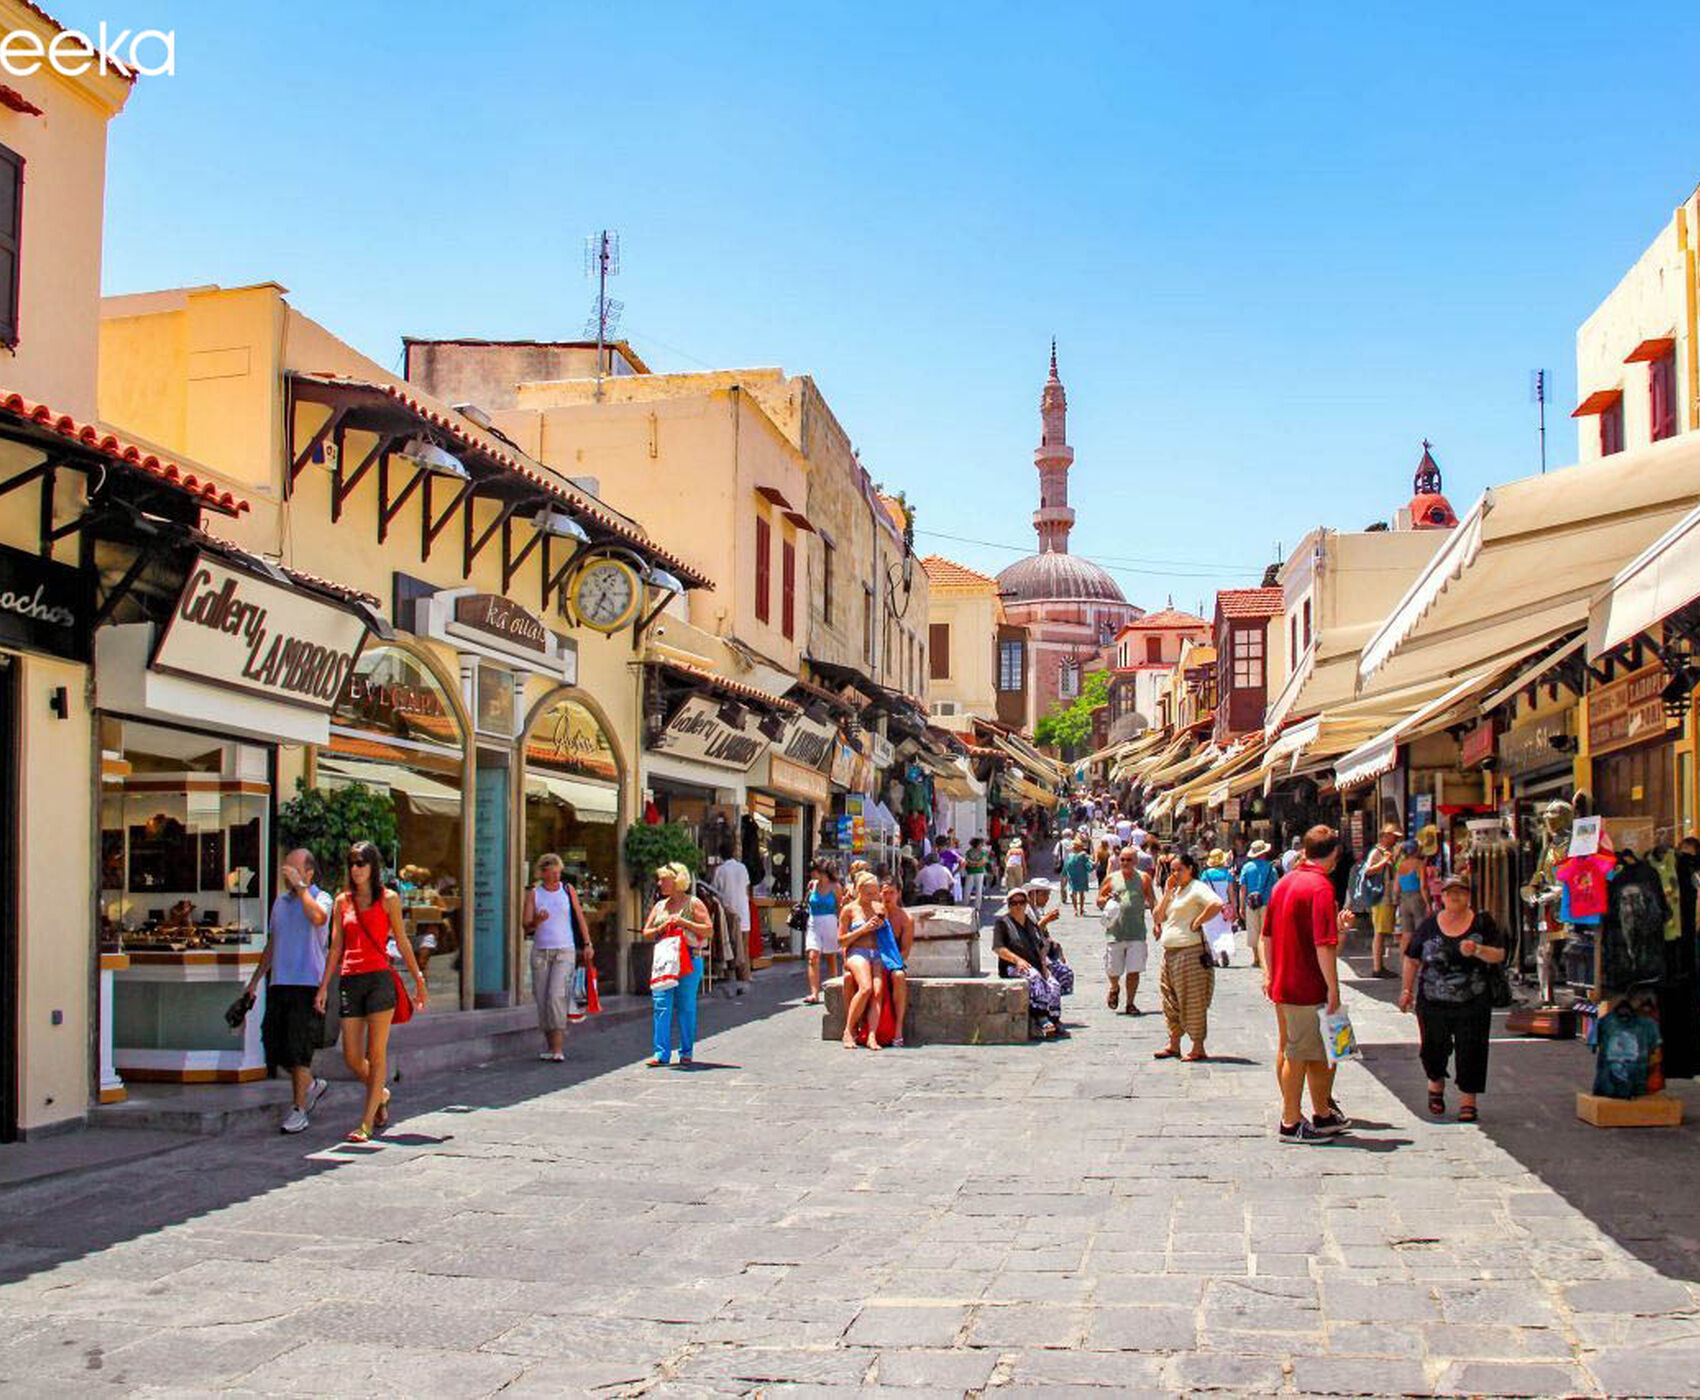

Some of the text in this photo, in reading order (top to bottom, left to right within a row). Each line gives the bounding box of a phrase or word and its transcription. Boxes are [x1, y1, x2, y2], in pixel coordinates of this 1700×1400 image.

[181, 569, 267, 647] Gallery
[241, 629, 351, 700] LAMBROS
[671, 706, 718, 741] Gallery
